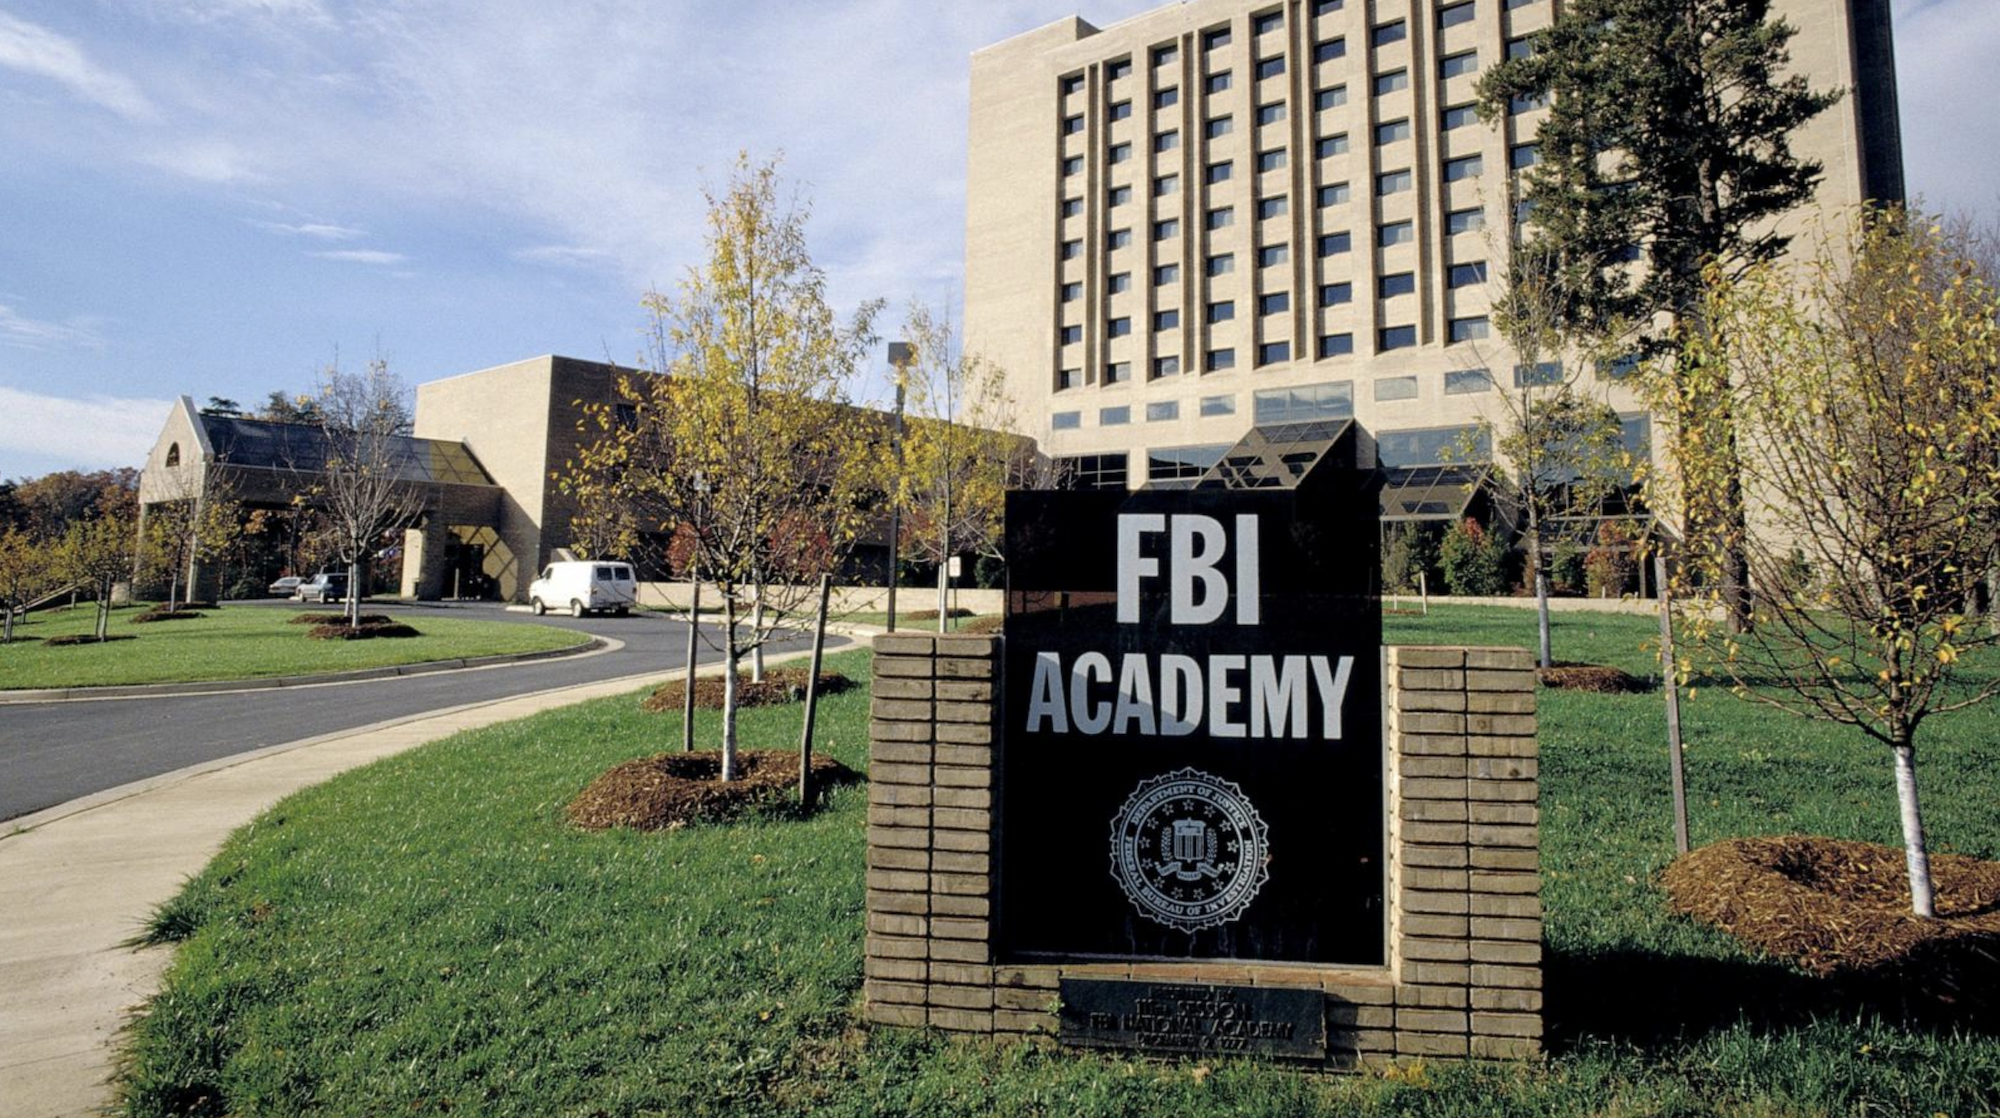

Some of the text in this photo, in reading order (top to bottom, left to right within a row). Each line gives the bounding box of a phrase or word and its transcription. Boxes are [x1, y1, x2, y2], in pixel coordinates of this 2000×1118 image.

[1117, 513, 1260, 625] FBI
[1026, 651, 1355, 740] ACADEMY
[1131, 785, 1249, 829] DEPARTMENT OF JUSTICE
[1125, 836, 1253, 916] FEDERAL BUREAU OF INVESTIGATION
